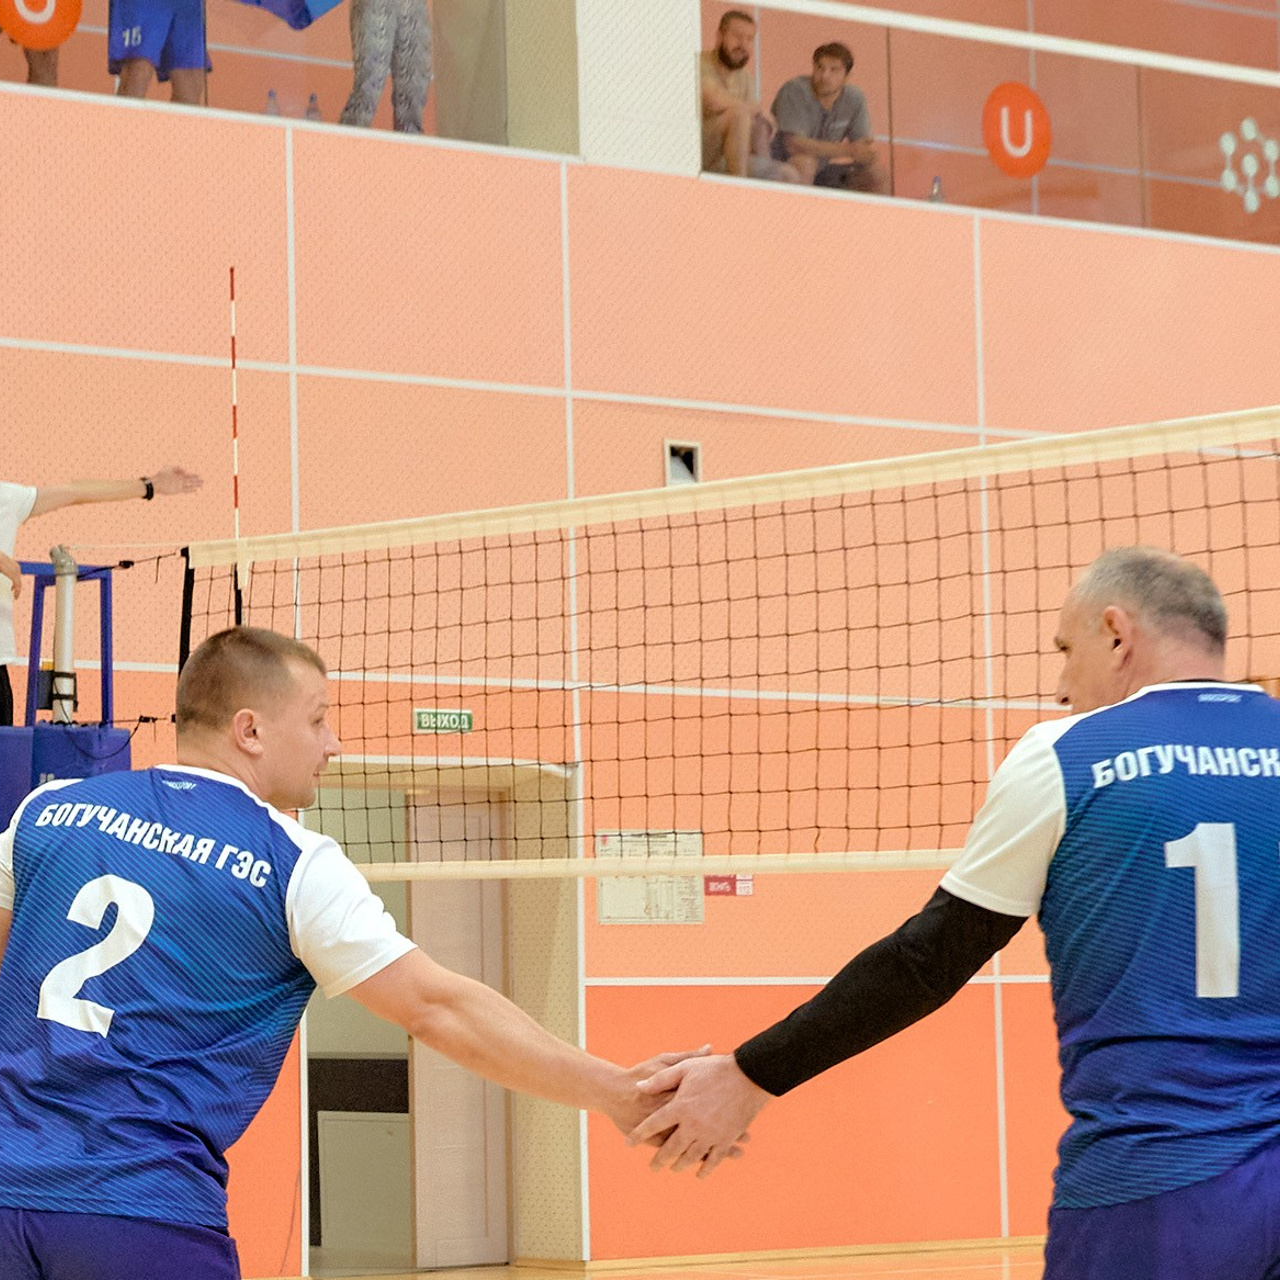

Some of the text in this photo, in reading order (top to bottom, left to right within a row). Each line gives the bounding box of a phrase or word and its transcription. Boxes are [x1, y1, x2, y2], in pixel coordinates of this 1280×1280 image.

[1001, 106, 1033, 158] U
[420, 712, 470, 730] ВЫХОД
[1091, 744, 1280, 789] БОГУЧАНСК
[34, 802, 272, 889] БОГУЧАНСКАЯ ГЭС
[1164, 822, 1280, 998] 1
[37, 874, 155, 1039] 2
